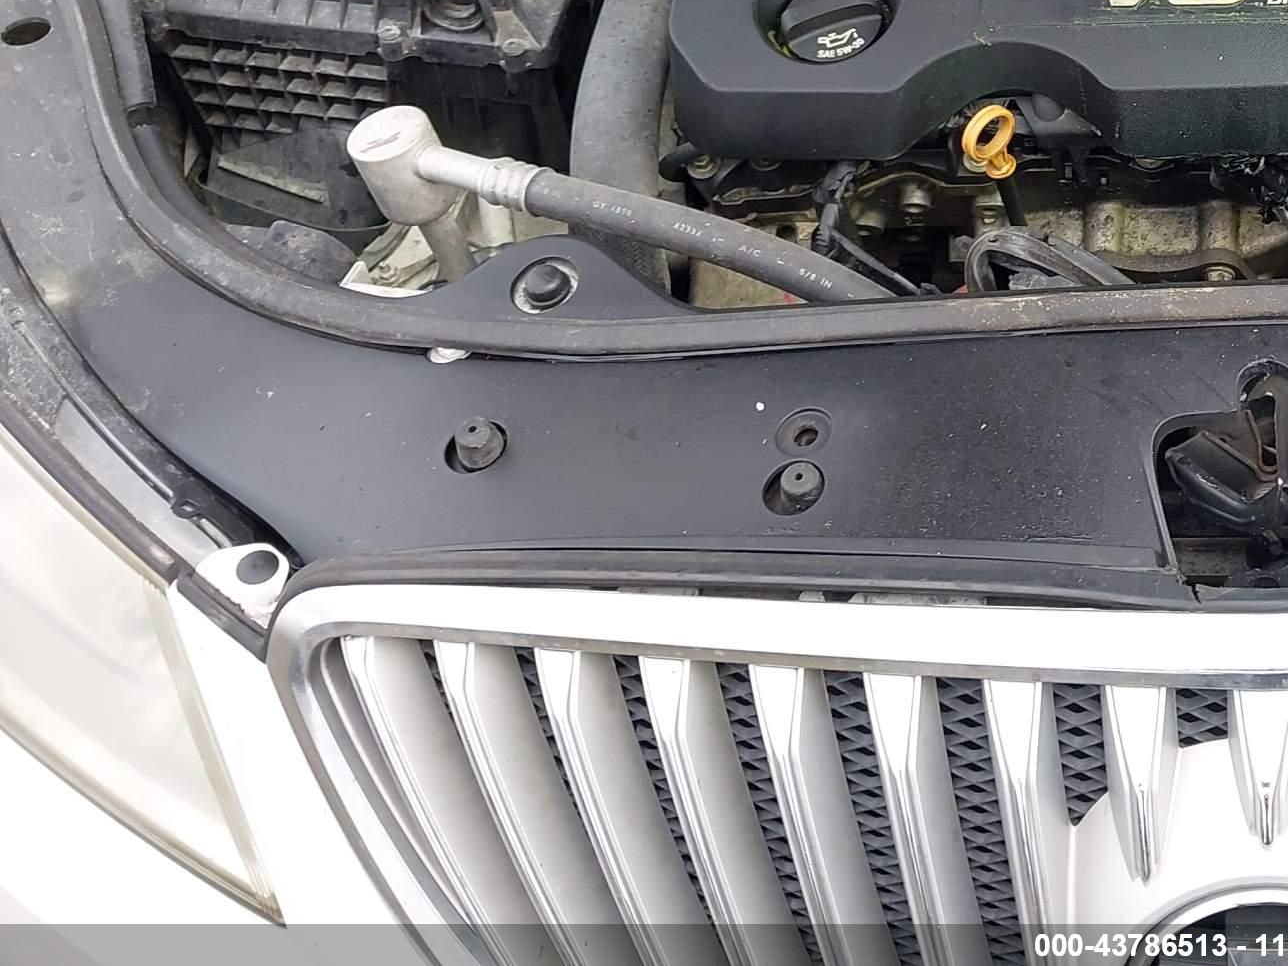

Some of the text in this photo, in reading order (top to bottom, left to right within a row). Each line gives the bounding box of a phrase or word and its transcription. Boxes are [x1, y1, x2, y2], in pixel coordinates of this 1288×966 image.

[817, 37, 865, 58] SAE 5W-30
[738, 244, 762, 258] A/C
[819, 277, 833, 289] IN
